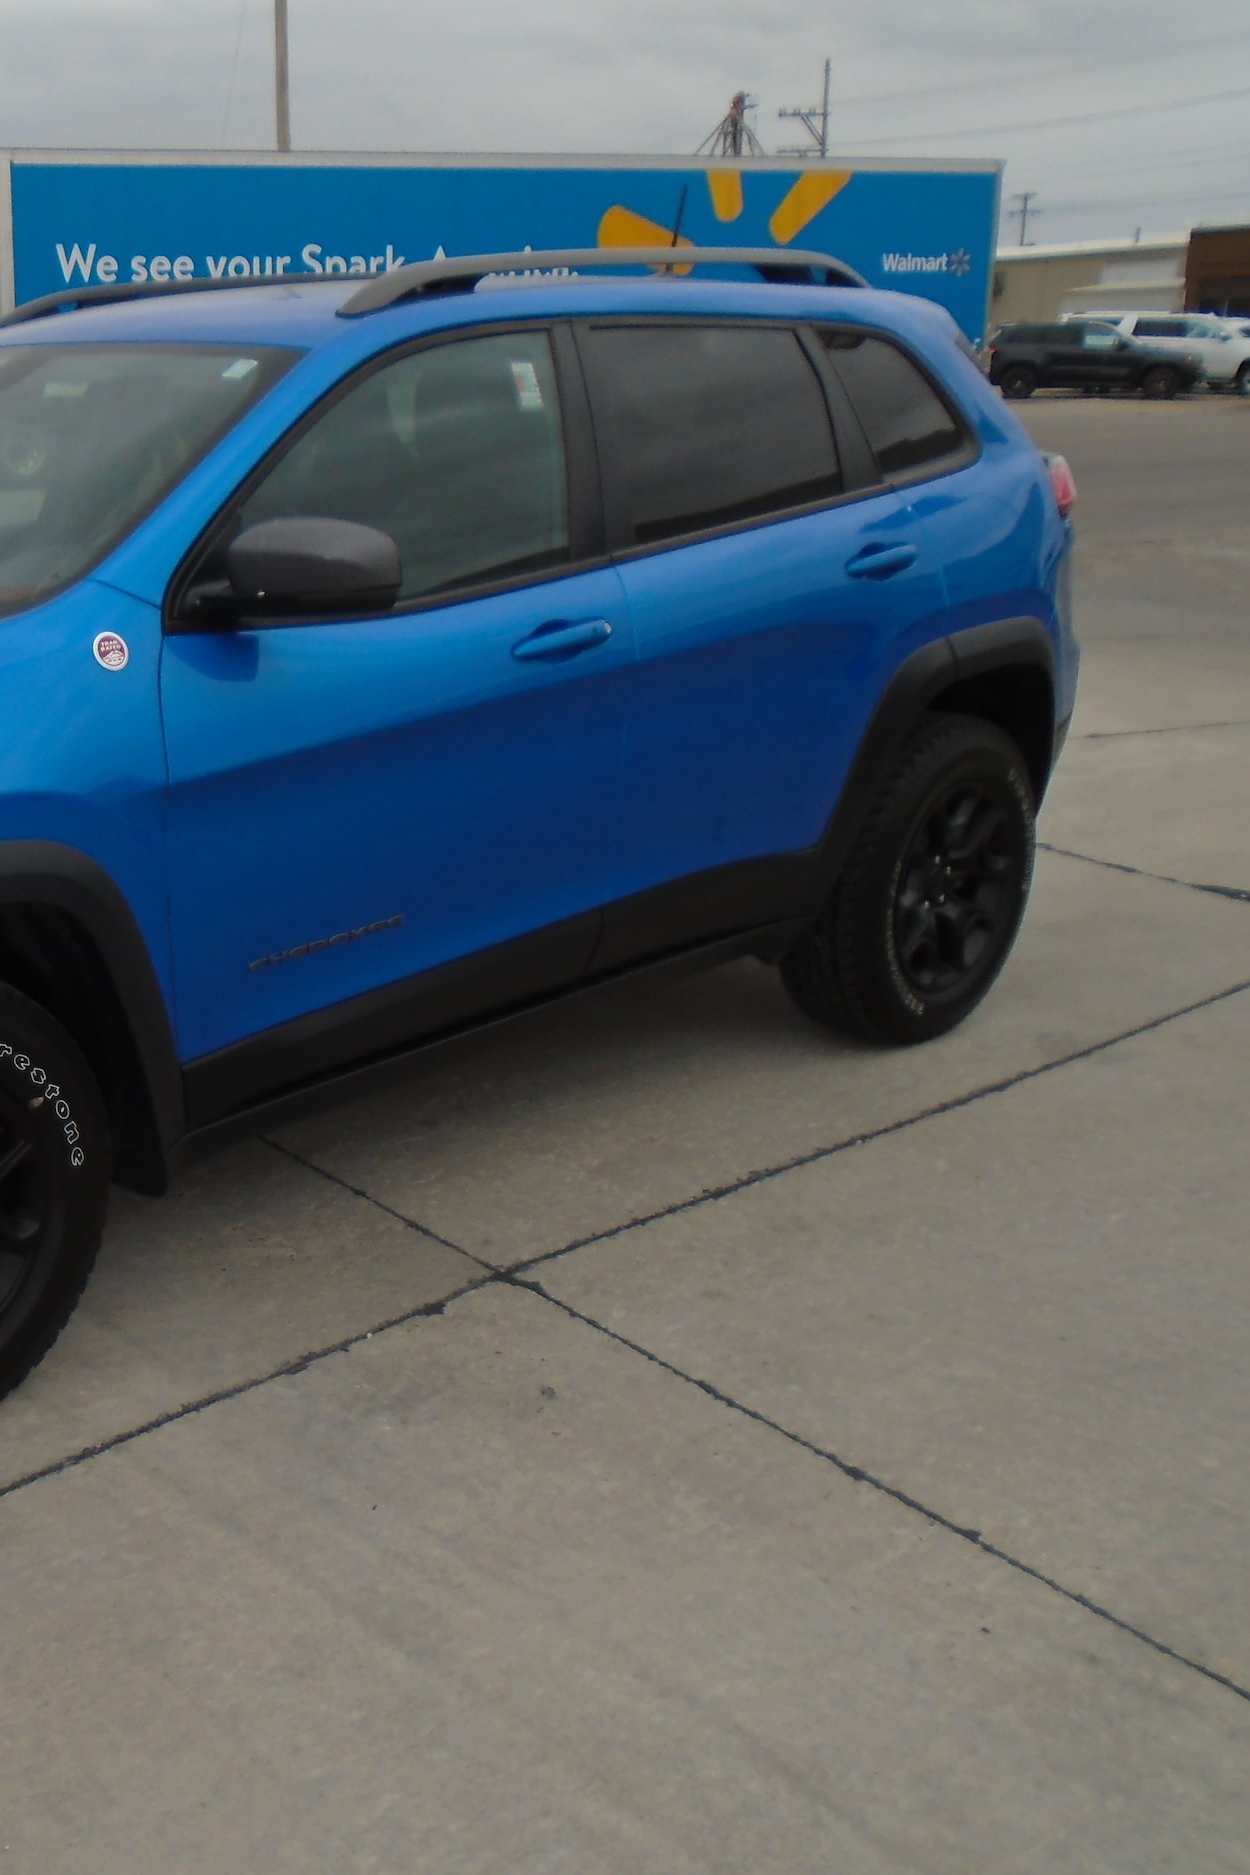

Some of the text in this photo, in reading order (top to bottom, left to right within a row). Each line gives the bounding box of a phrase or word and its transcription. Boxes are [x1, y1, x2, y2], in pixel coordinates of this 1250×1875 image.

[56, 243, 119, 284] We
[131, 255, 195, 281] see
[882, 252, 948, 272] Walmart
